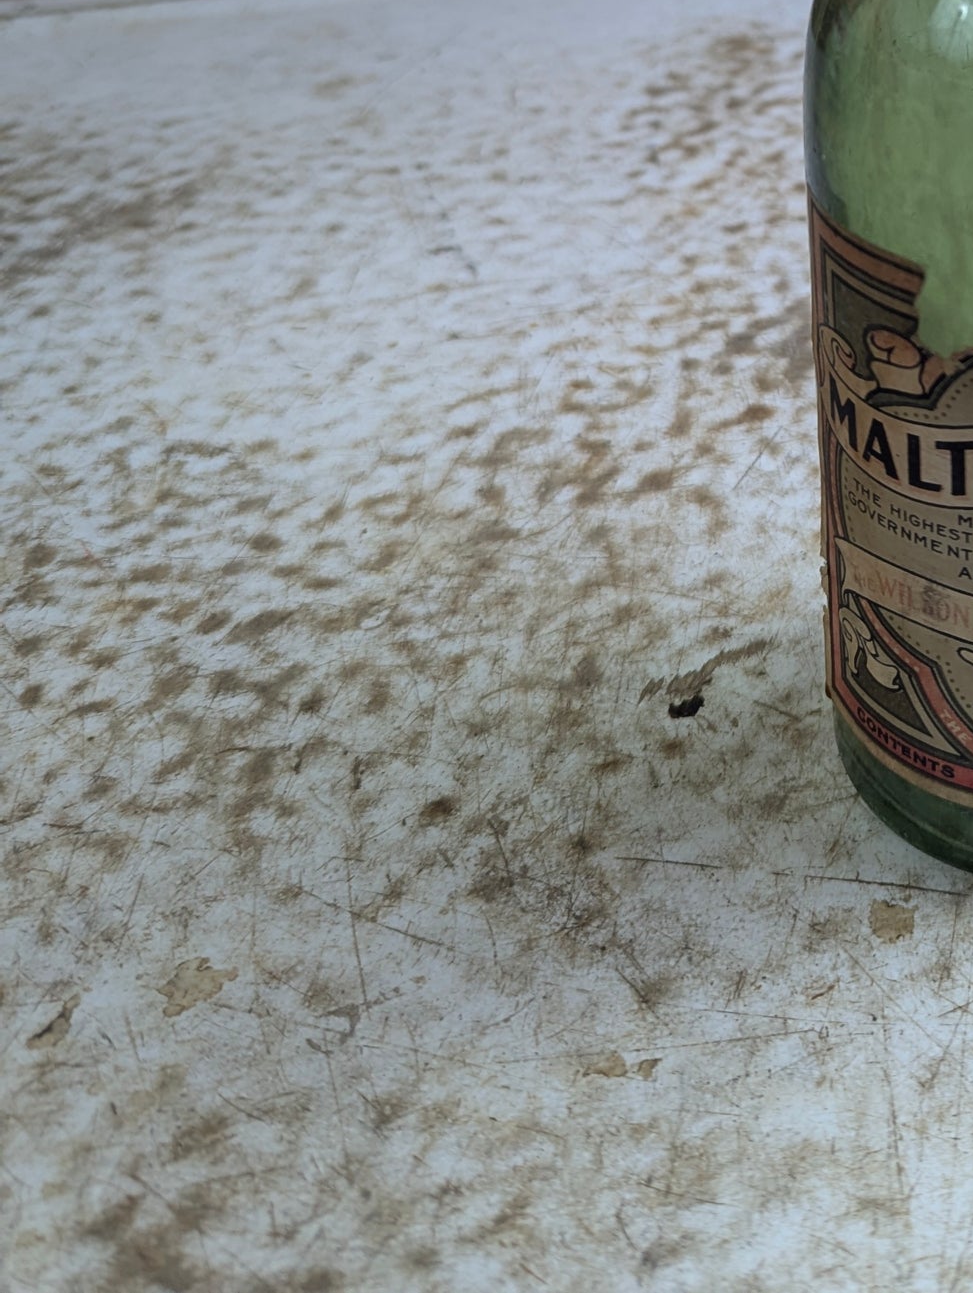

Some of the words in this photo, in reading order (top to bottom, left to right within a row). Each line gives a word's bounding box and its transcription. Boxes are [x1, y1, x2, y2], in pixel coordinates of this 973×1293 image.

[848, 491, 973, 562] GOVERNMENT
[852, 477, 882, 508] THE
[890, 504, 973, 544] HIGHEST
[856, 706, 956, 779] CONTENTS
[939, 708, 973, 746] THE
